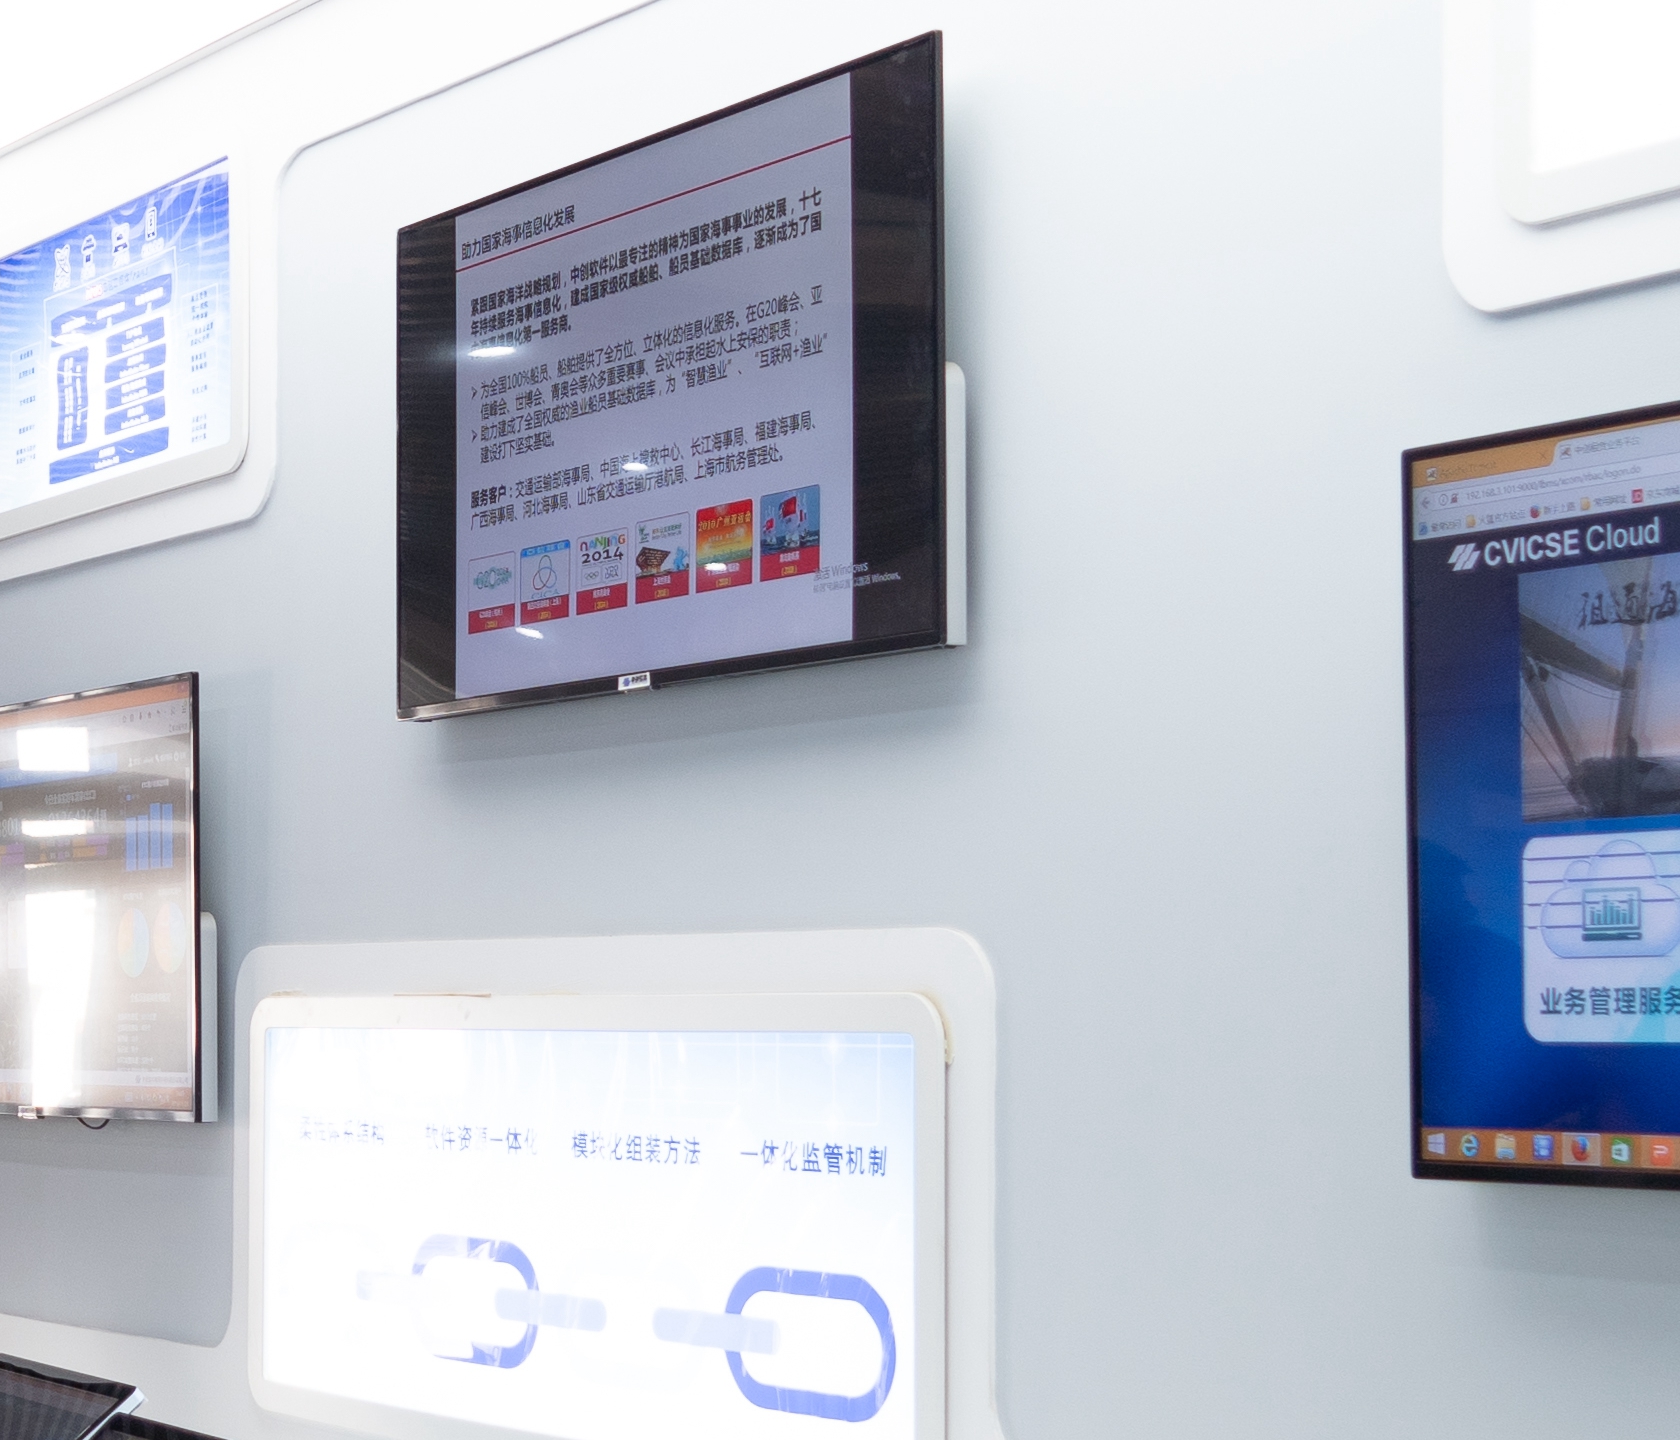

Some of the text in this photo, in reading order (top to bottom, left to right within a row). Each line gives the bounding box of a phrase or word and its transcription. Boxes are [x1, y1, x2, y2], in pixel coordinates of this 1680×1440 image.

[461, 204, 575, 261] 助力国家海事信息化发展
[579, 533, 627, 552] NANJING
[581, 547, 624, 564] 2014
[1483, 515, 1661, 567] CVICSE Cloud
[425, 1121, 539, 1156] 软件资源一体化
[570, 1129, 701, 1166] 模块化组装方法
[739, 1138, 888, 1178] 一体化监管机制
